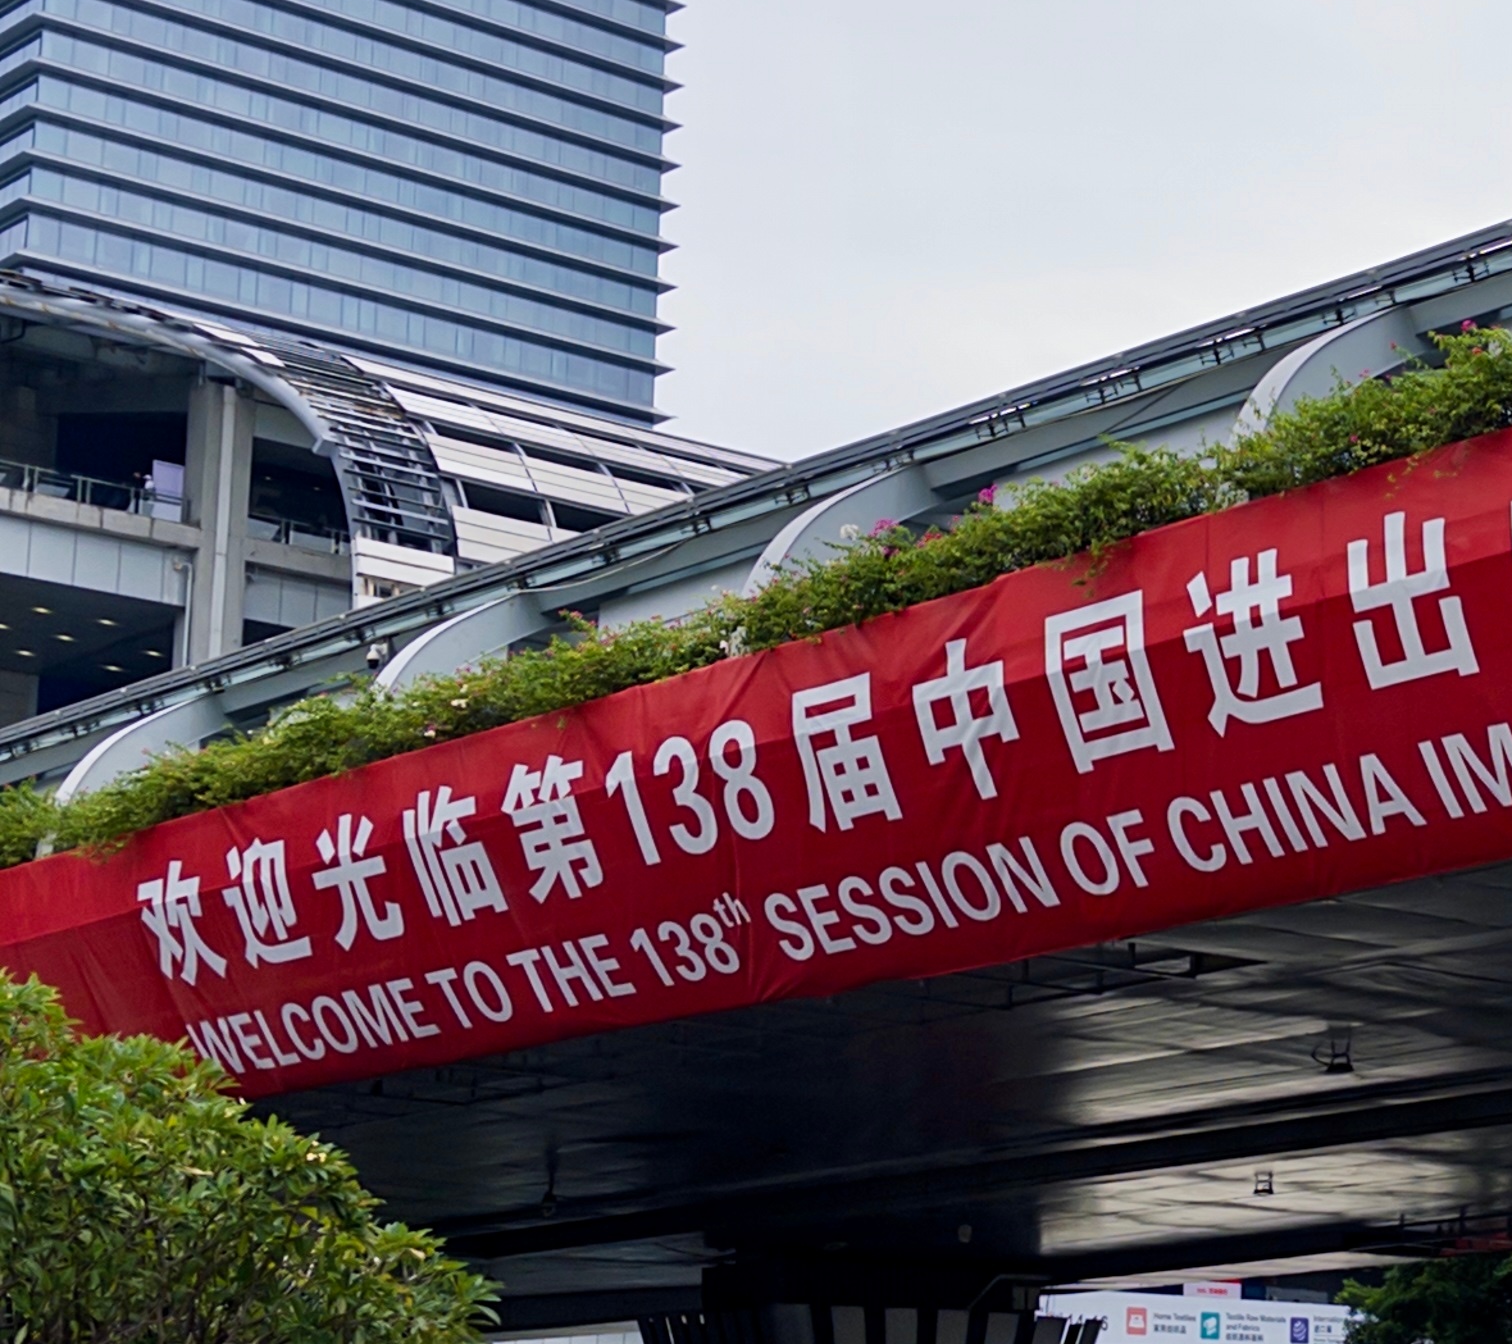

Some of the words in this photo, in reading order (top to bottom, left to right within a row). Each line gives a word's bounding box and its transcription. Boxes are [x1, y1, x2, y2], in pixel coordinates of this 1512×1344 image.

[186, 977, 440, 1074] WELCOME
[426, 961, 513, 1028] TO
[508, 934, 636, 1014] THE
[630, 892, 751, 987] 138th
[764, 836, 1061, 961] SESSION
[1060, 810, 1154, 895] OF
[1167, 753, 1427, 873] CHINA
